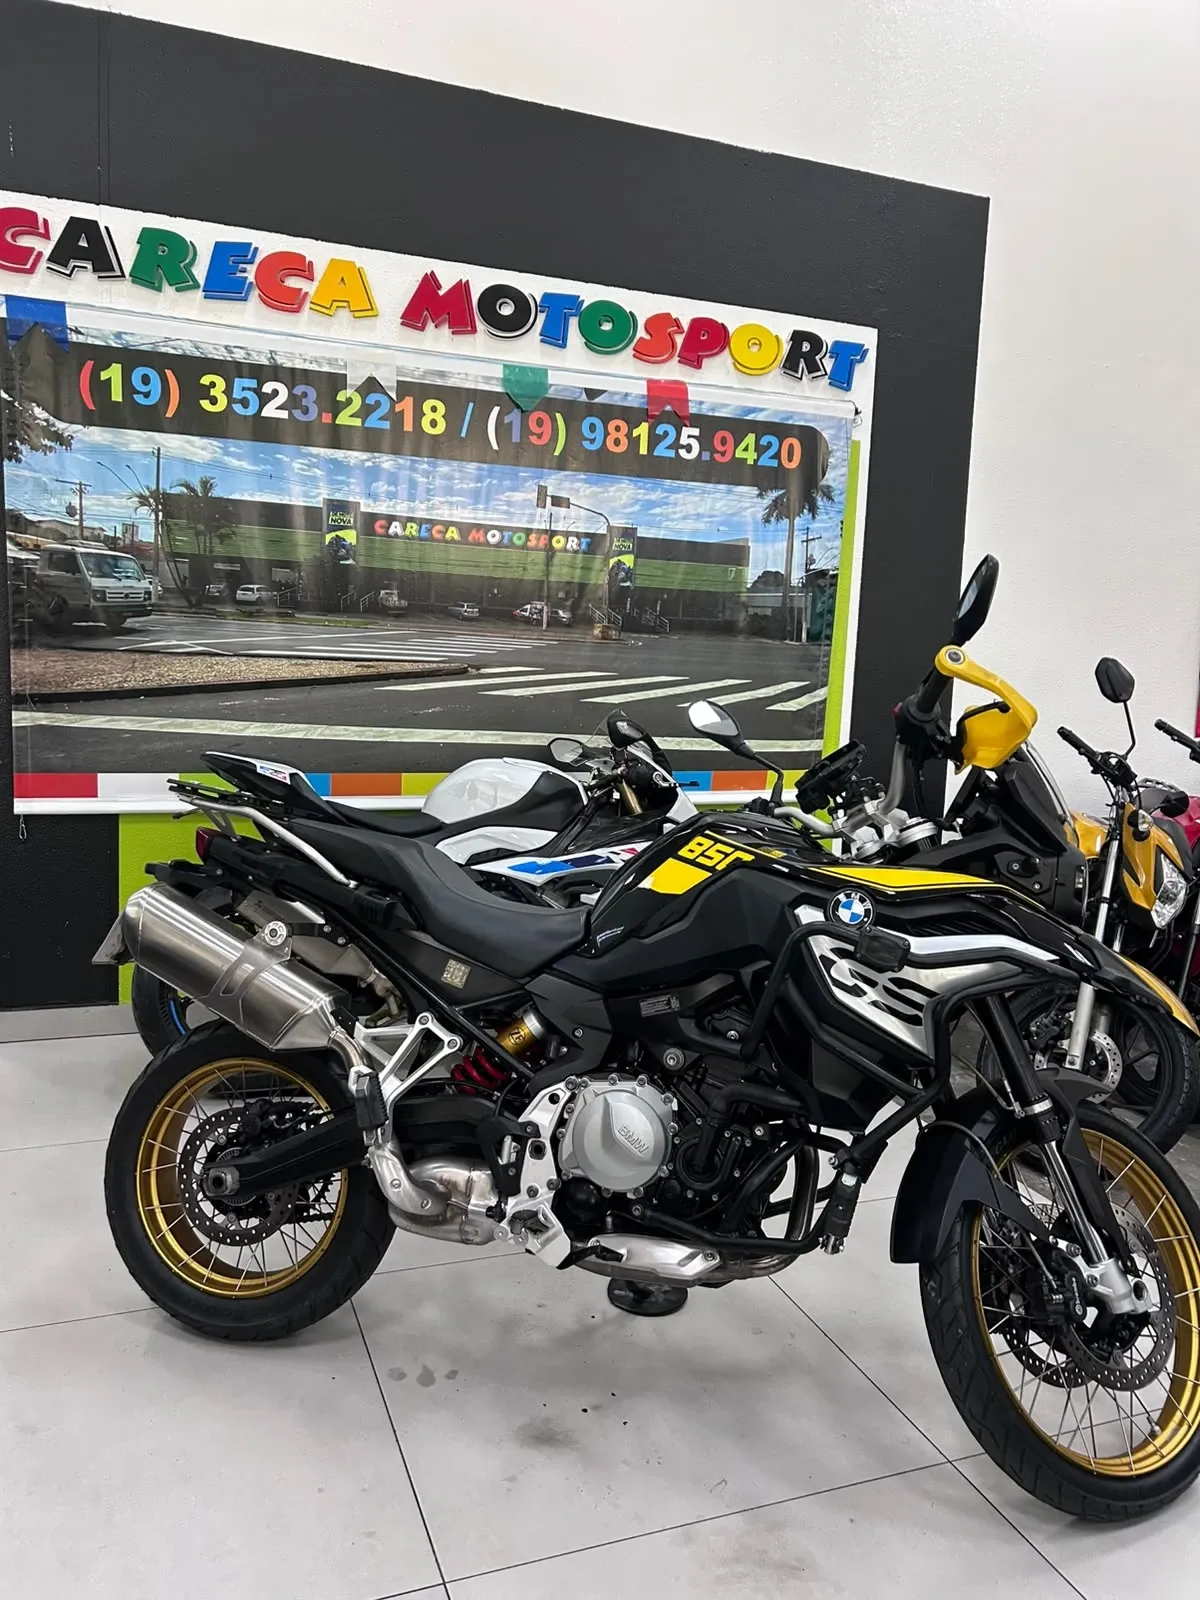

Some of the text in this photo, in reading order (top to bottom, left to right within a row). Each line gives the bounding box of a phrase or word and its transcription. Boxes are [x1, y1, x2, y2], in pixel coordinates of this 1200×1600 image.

[0, 206, 869, 392] CARECA MOTOSPORT
[79, 359, 180, 419] (19)
[200, 374, 447, 436] 3523.2218
[487, 405, 567, 456] (19)
[581, 416, 801, 470] 98125.9420
[330, 517, 352, 525] NOVA
[373, 519, 592, 552] CARECA MOTOSPORT
[617, 1123, 650, 1154] BMW
